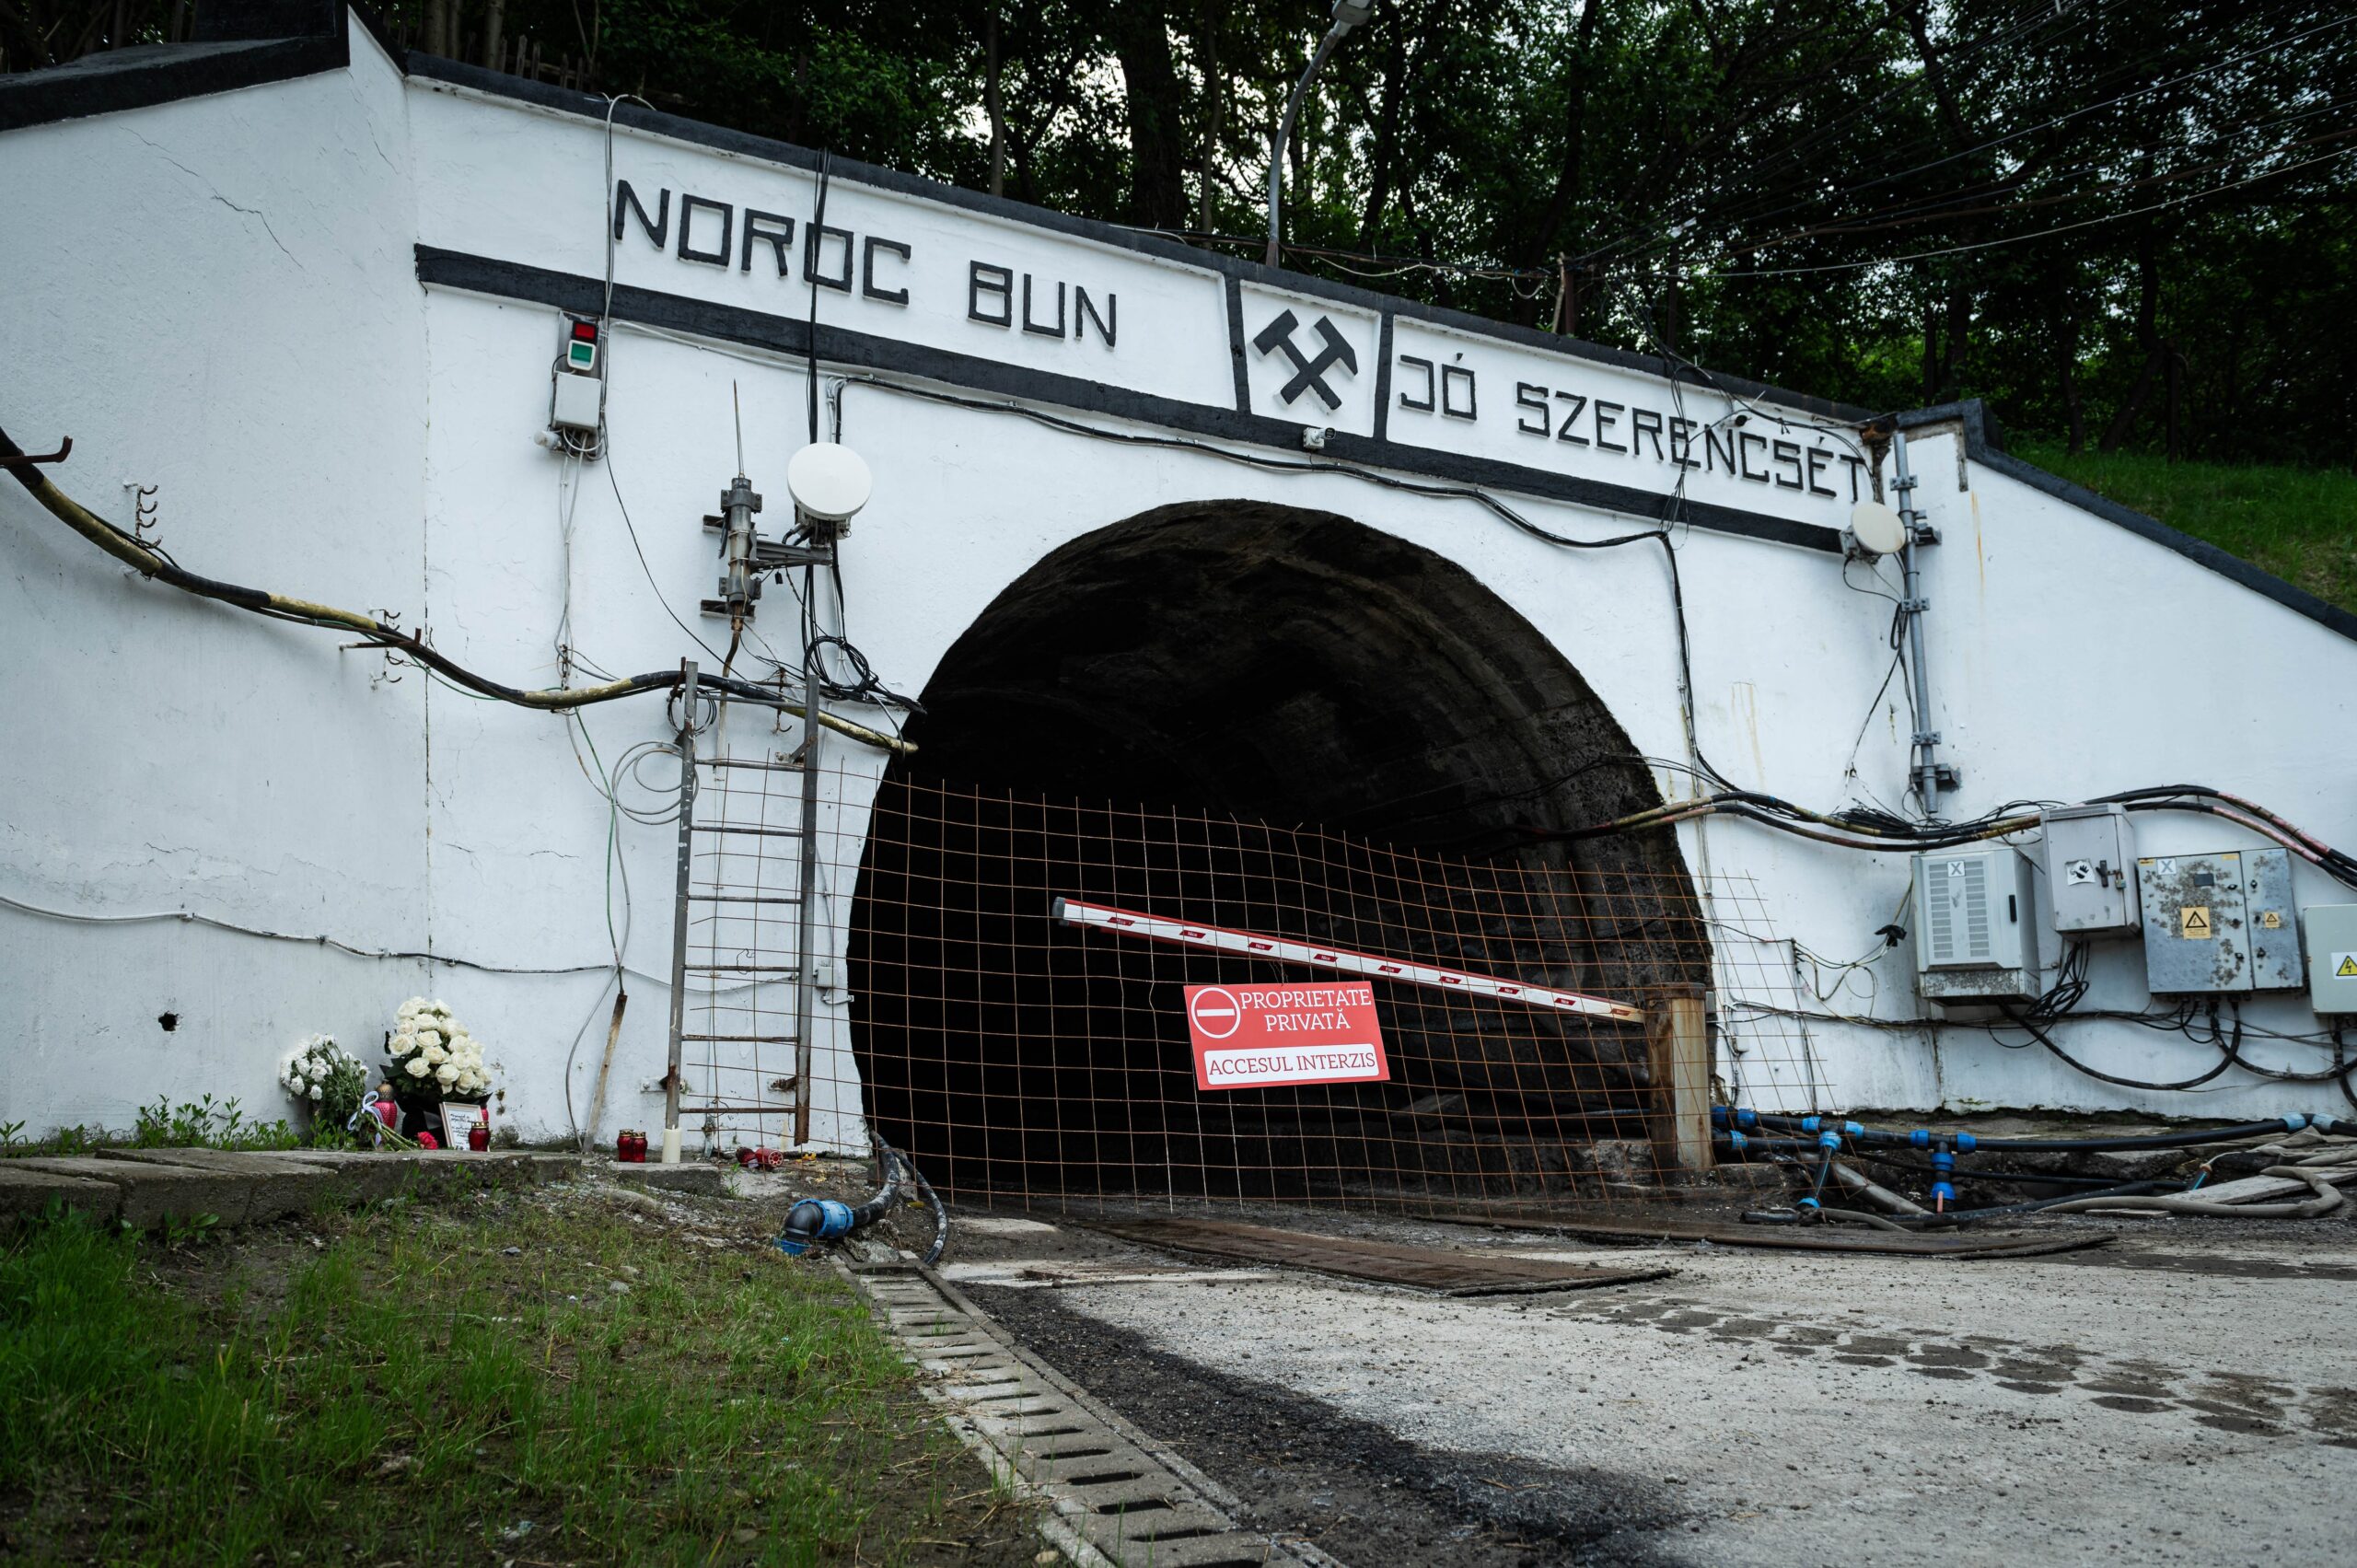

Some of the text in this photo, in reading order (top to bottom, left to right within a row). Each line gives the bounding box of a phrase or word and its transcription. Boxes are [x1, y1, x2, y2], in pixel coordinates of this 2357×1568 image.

[614, 179, 1117, 348] NOROC BUN
[1399, 353, 1868, 503] JÓ SZERENCSÉT
[1239, 988, 1372, 1010] PROPRIETATE
[1264, 1007, 1352, 1032] PRIVATĂ
[1209, 1052, 1376, 1075] ACCESUL INTERZIS
